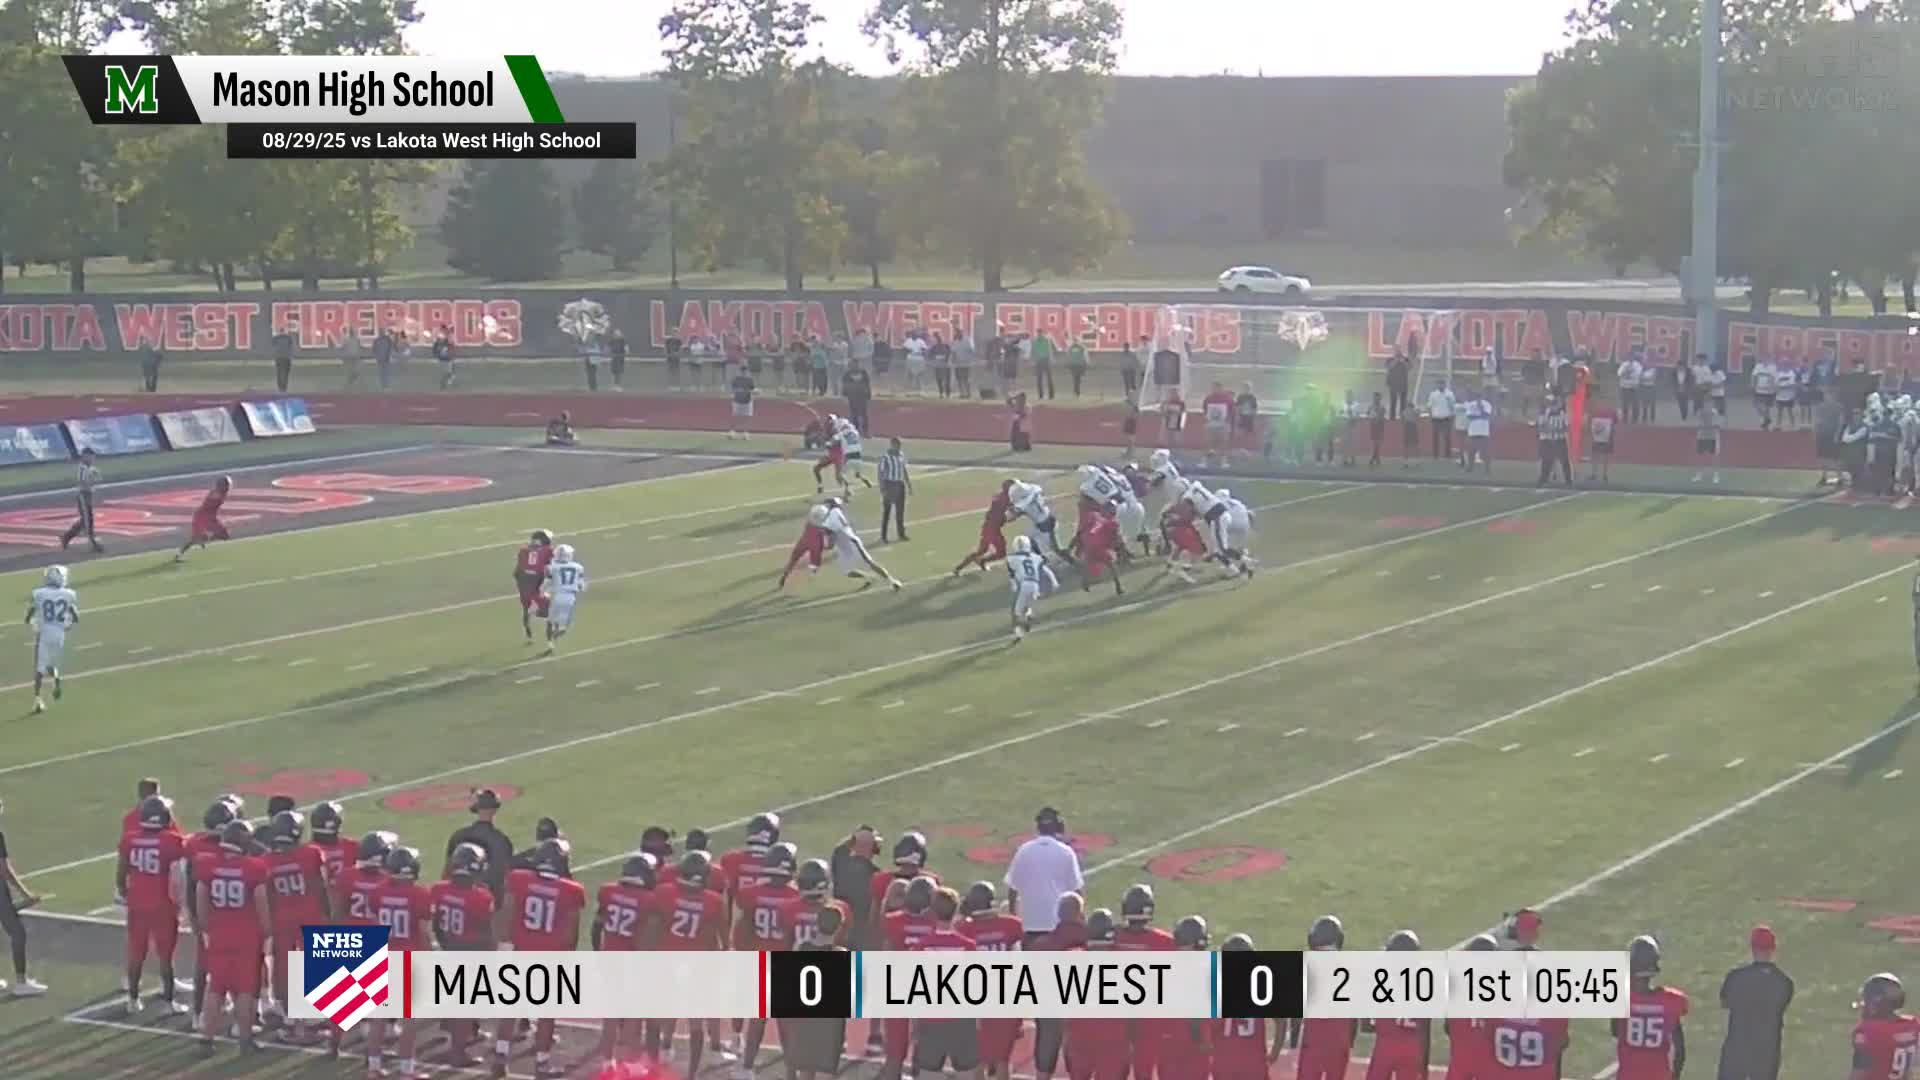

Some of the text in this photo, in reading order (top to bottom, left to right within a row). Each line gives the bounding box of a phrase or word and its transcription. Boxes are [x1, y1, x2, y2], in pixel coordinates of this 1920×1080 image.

[115, 303, 260, 350] WEST
[272, 300, 522, 349] FIREBIRDS
[650, 300, 1241, 352] LAKOTA WEST FIREBIRDS
[1368, 308, 1554, 359] LAKOTA
[560, 567, 577, 585] 17
[1022, 558, 1036, 578] 6
[43, 599, 69, 623] 82
[129, 847, 161, 875] 46
[210, 879, 245, 909] 99
[273, 872, 306, 896] 94
[438, 904, 466, 936] 38
[523, 896, 556, 933] 91
[604, 904, 638, 937] 32
[670, 910, 701, 939] 21
[1495, 1028, 1544, 1067] 69
[1626, 1017, 1664, 1048] 85
